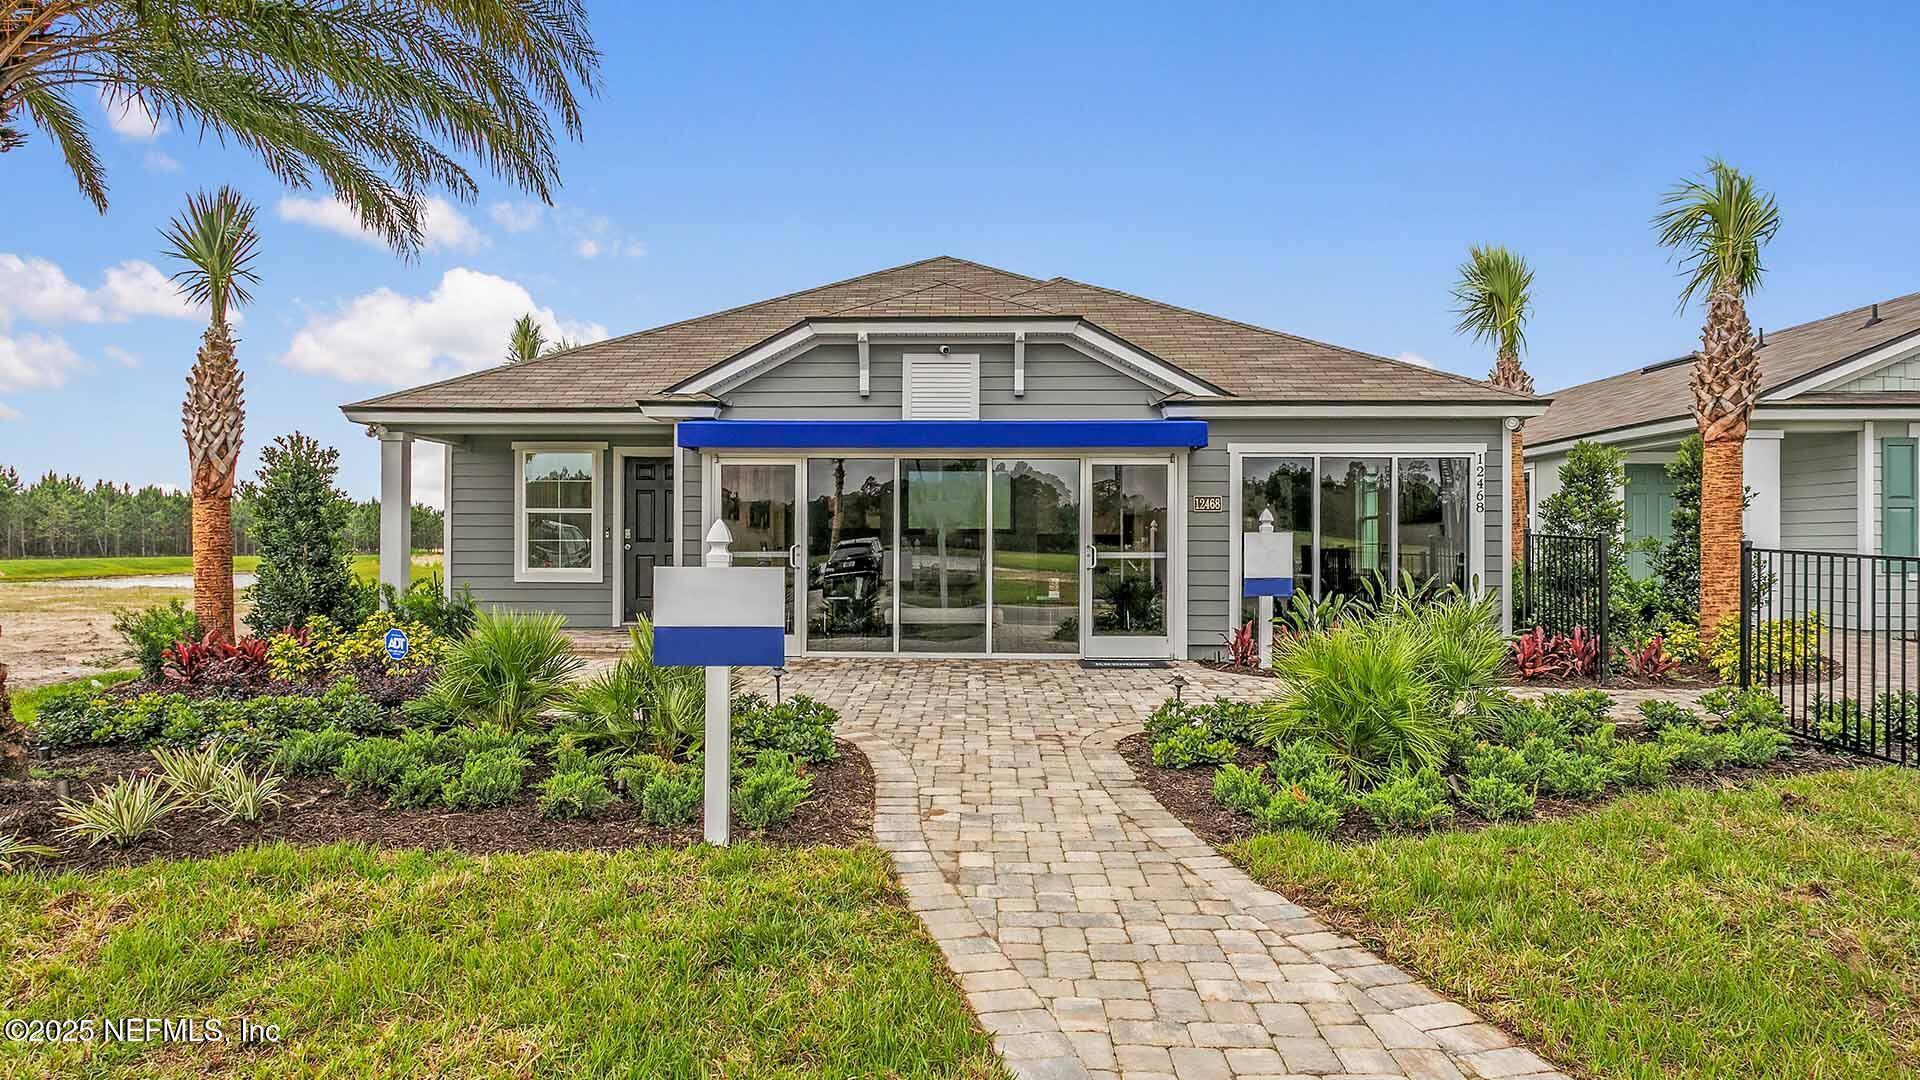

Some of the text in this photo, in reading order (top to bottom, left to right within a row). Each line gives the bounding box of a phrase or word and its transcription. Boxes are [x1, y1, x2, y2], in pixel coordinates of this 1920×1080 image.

[1476, 453, 1485, 513] 12468
[1195, 498, 1221, 510] 12468
[387, 637, 406, 650] ADT
